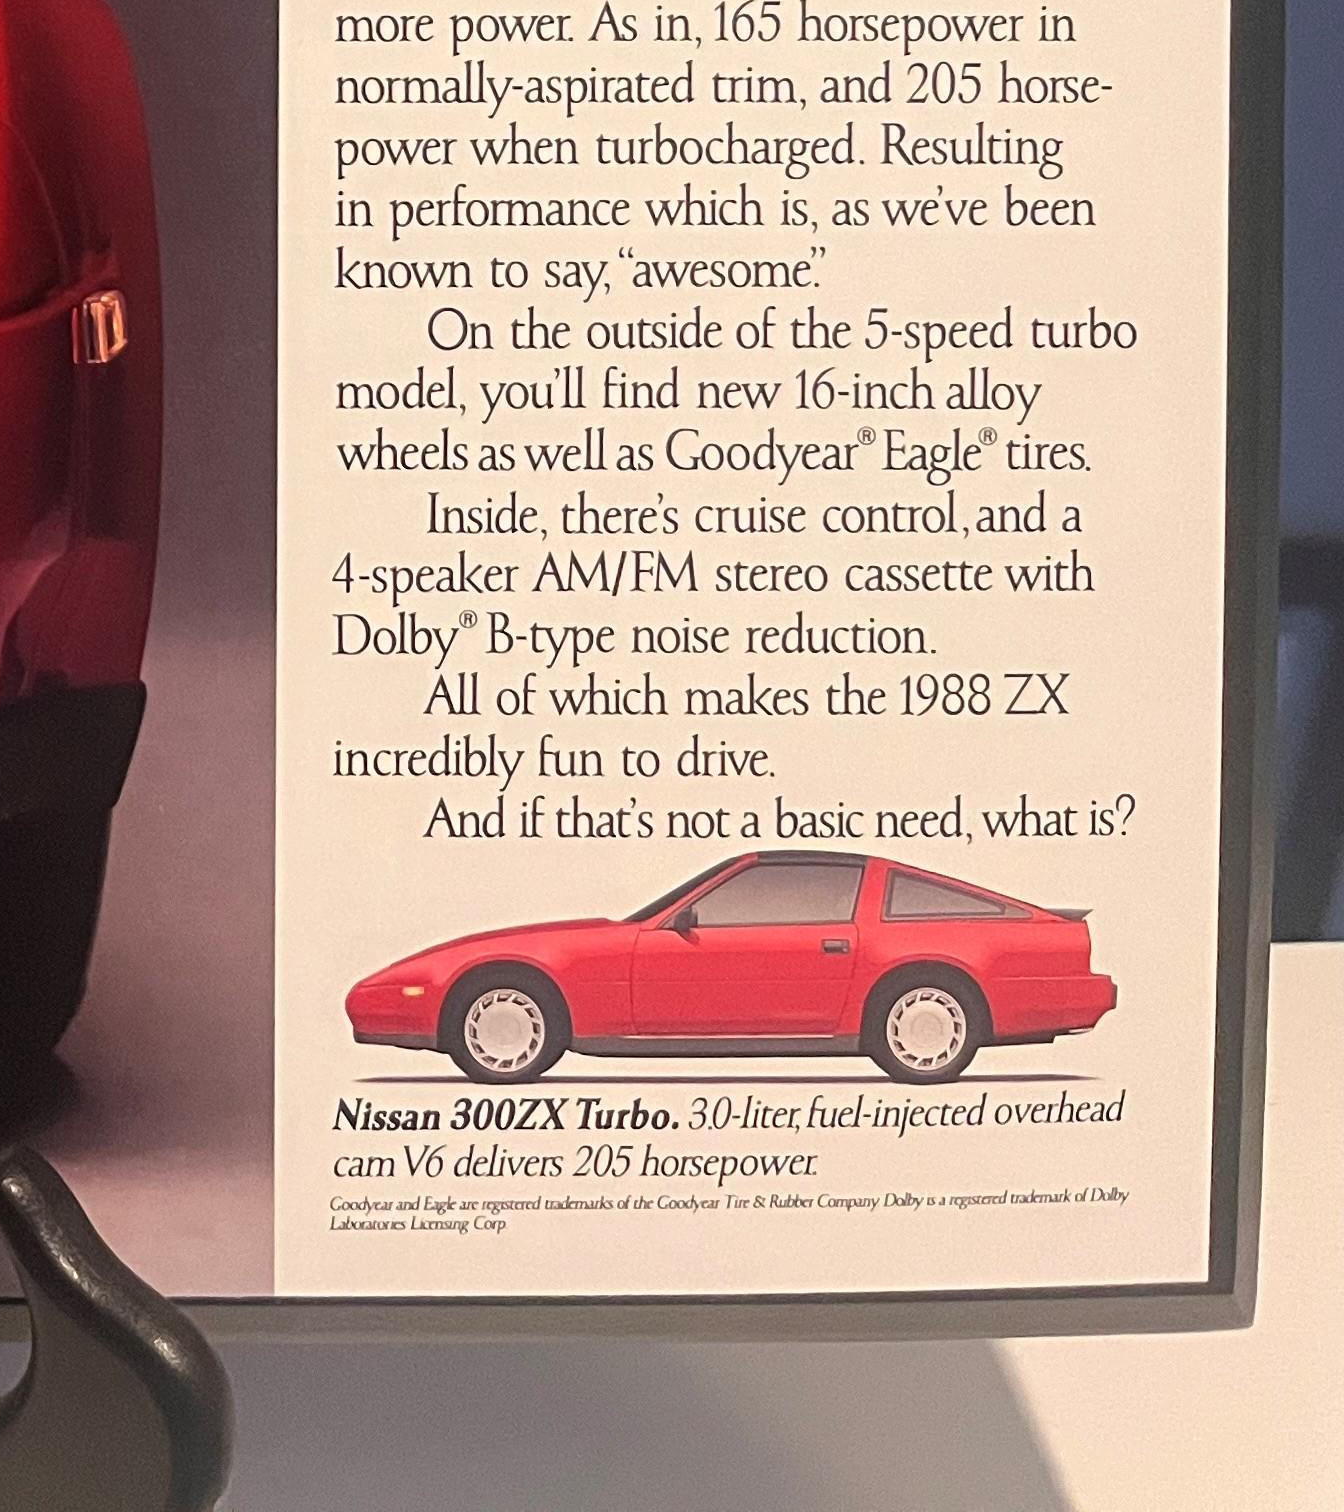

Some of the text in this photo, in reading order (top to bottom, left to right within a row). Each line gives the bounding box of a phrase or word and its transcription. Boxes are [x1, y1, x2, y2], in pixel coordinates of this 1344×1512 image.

[335, 15, 434, 42] more
[449, 15, 573, 56] power.
[588, 1, 637, 41] As
[654, 5, 701, 49] in,
[715, 0, 781, 42] 165
[1038, 6, 1077, 41] in
[335, 60, 1112, 119] normally-aspirated trim, and 205 horse-
[334, 121, 1064, 180] power when turbocharged. Resulting
[428, 305, 1137, 363] On the outside of the 5-speed turbo
[332, 549, 1095, 608] 4-speaker AM/FM stereo cassette with
[423, 672, 1070, 716] All of which makes the 1988 ZX
[332, 1089, 1126, 1137] Nissan 300ZX Turbo. 3.0-liter, fuel-injected overhead
[334, 1143, 818, 1188] cam V6 delivers 205 horsepower.
